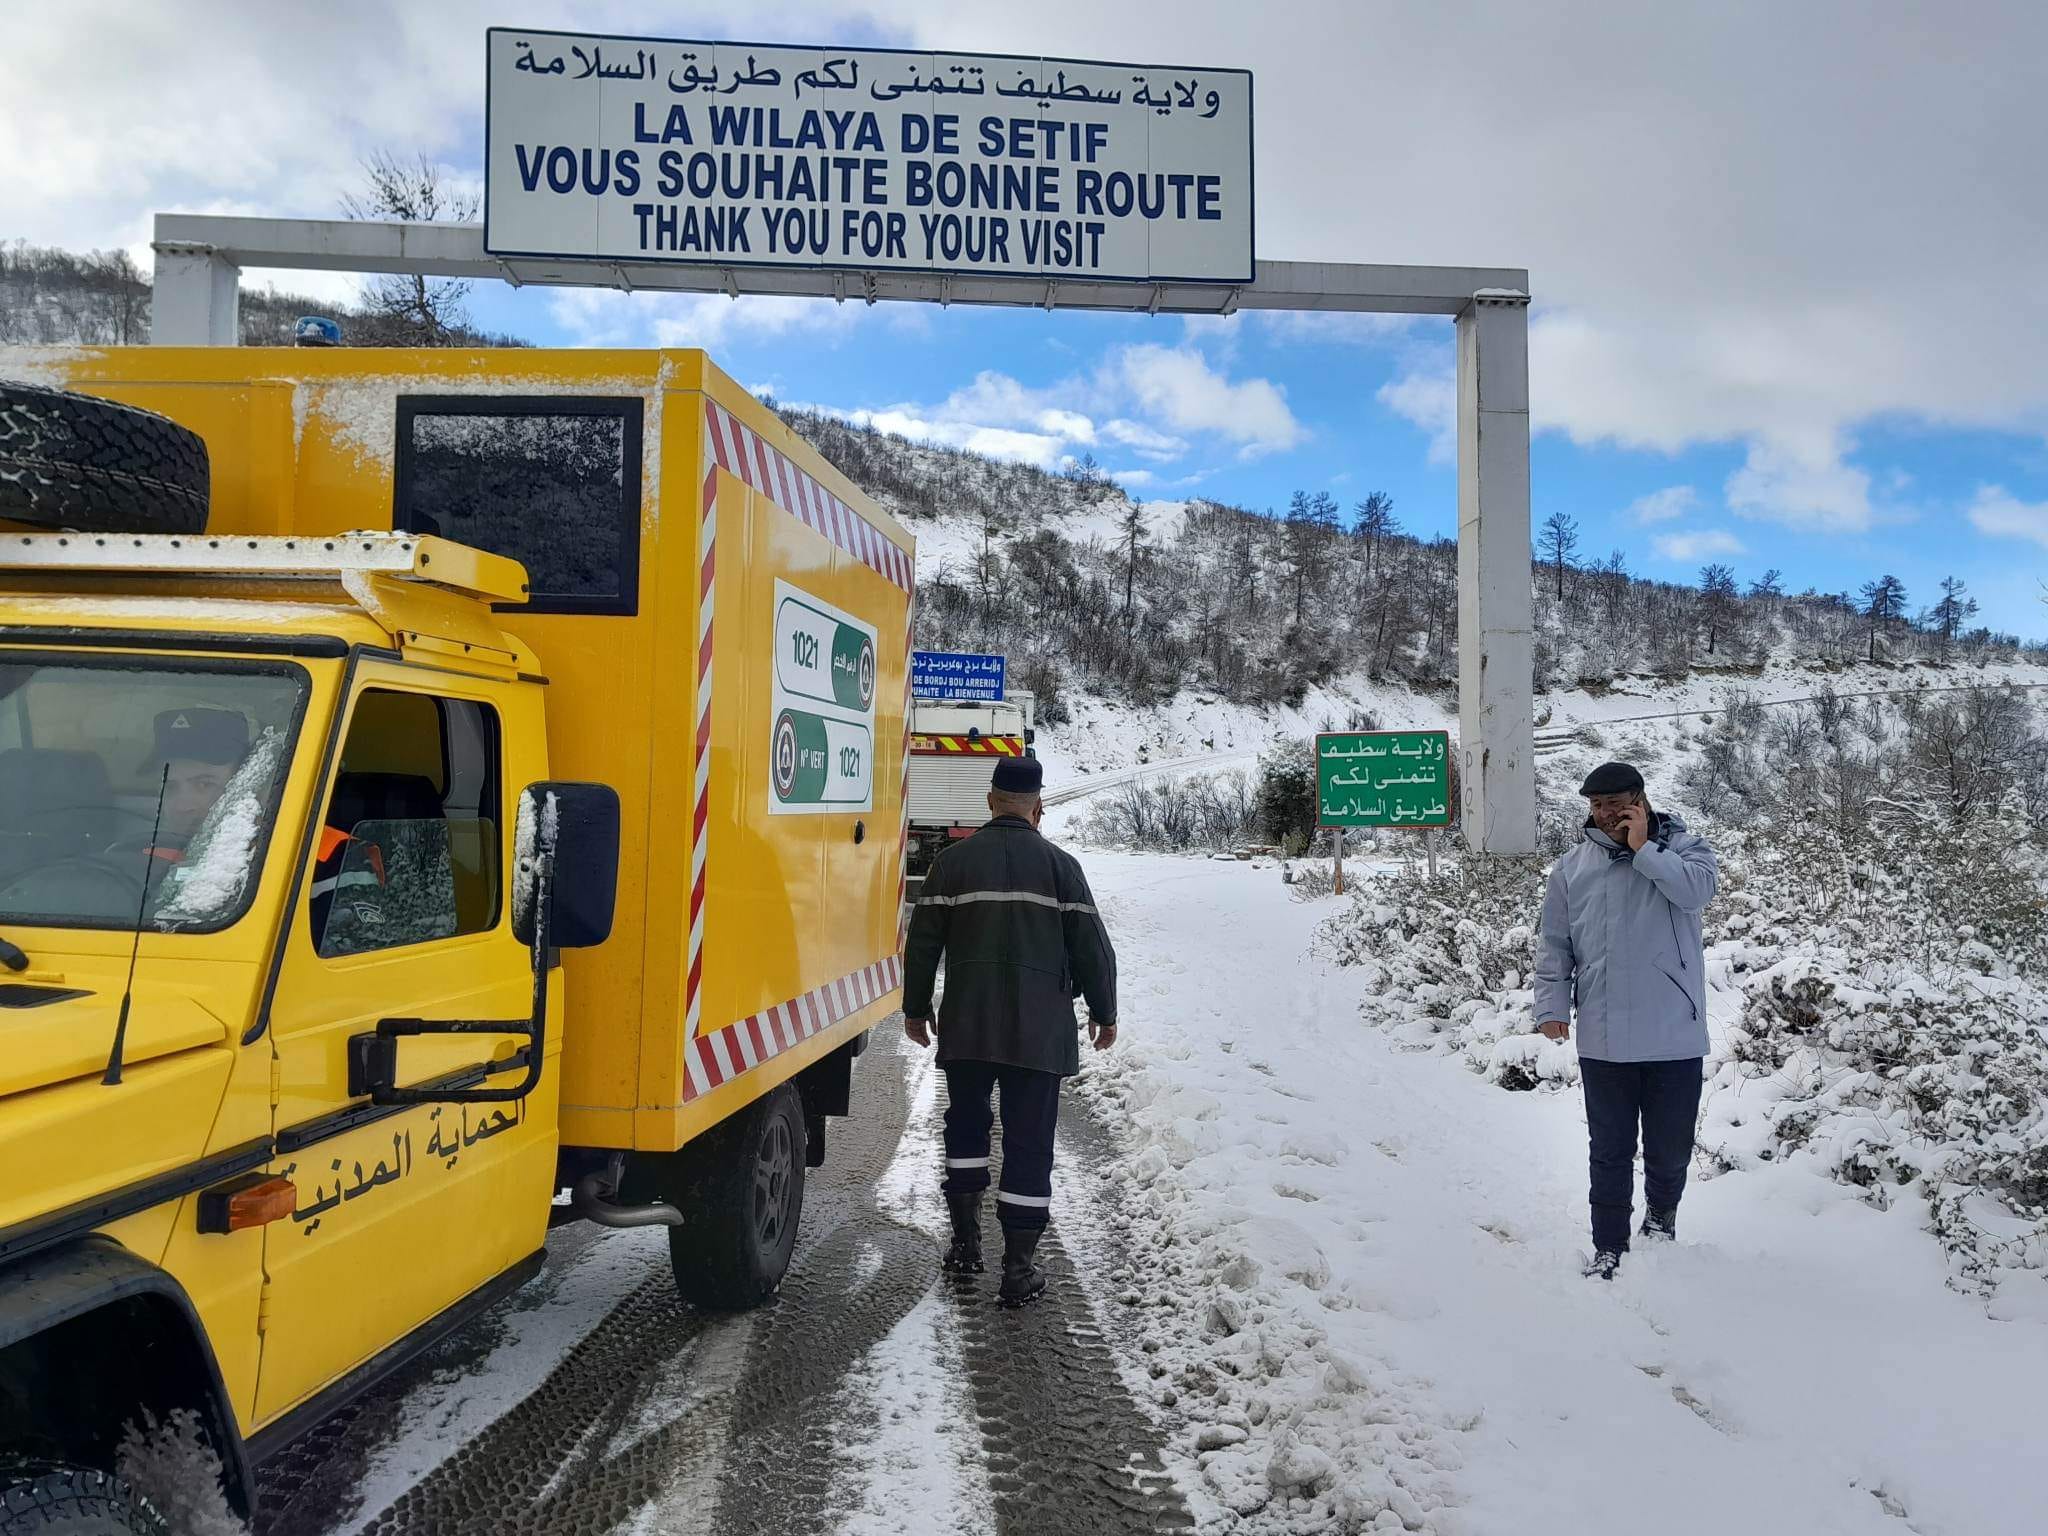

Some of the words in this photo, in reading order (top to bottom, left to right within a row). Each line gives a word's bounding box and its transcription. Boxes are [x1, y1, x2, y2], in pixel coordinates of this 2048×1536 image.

[514, 41, 657, 81] السلامة
[667, 53, 782, 94] طريق
[793, 58, 859, 100] لكم
[870, 65, 985, 101] تتمنى
[996, 62, 1122, 109] سطيف
[1131, 76, 1221, 118] ولاية
[634, 102, 693, 146] LA
[709, 106, 885, 152] WILAYA
[901, 113, 960, 155] DE
[977, 116, 1109, 163] SETIF
[514, 144, 641, 196] VOUS
[657, 151, 888, 205] SOUHAITE
[905, 161, 1060, 212] BONNE
[1077, 170, 1222, 220] ROUTE
[633, 204, 750, 254] THANK
[761, 207, 828, 258] YOU
[842, 210, 907, 258] FOR
[921, 214, 1010, 263] YOUR
[1019, 219, 1106, 269] VISIT
[793, 630, 818, 671] 1021
[912, 687, 939, 697] UHAITE
[944, 688, 953, 698] LA
[955, 689, 995, 700] BIENVENUE
[913, 675, 922, 684] DE
[924, 676, 947, 686] BORDJ
[949, 677, 963, 687] BOU
[965, 678, 1000, 689] ARRERIDJ
[810, 750, 825, 769] VERT
[839, 746, 860, 778] 1021
[1320, 738, 1387, 762] سطيف
[1391, 737, 1444, 760] ولاية
[1329, 766, 1369, 792] لكم
[1374, 766, 1436, 790] تتمنى
[1321, 797, 1386, 817] السلامة
[1390, 797, 1446, 822] طريق
